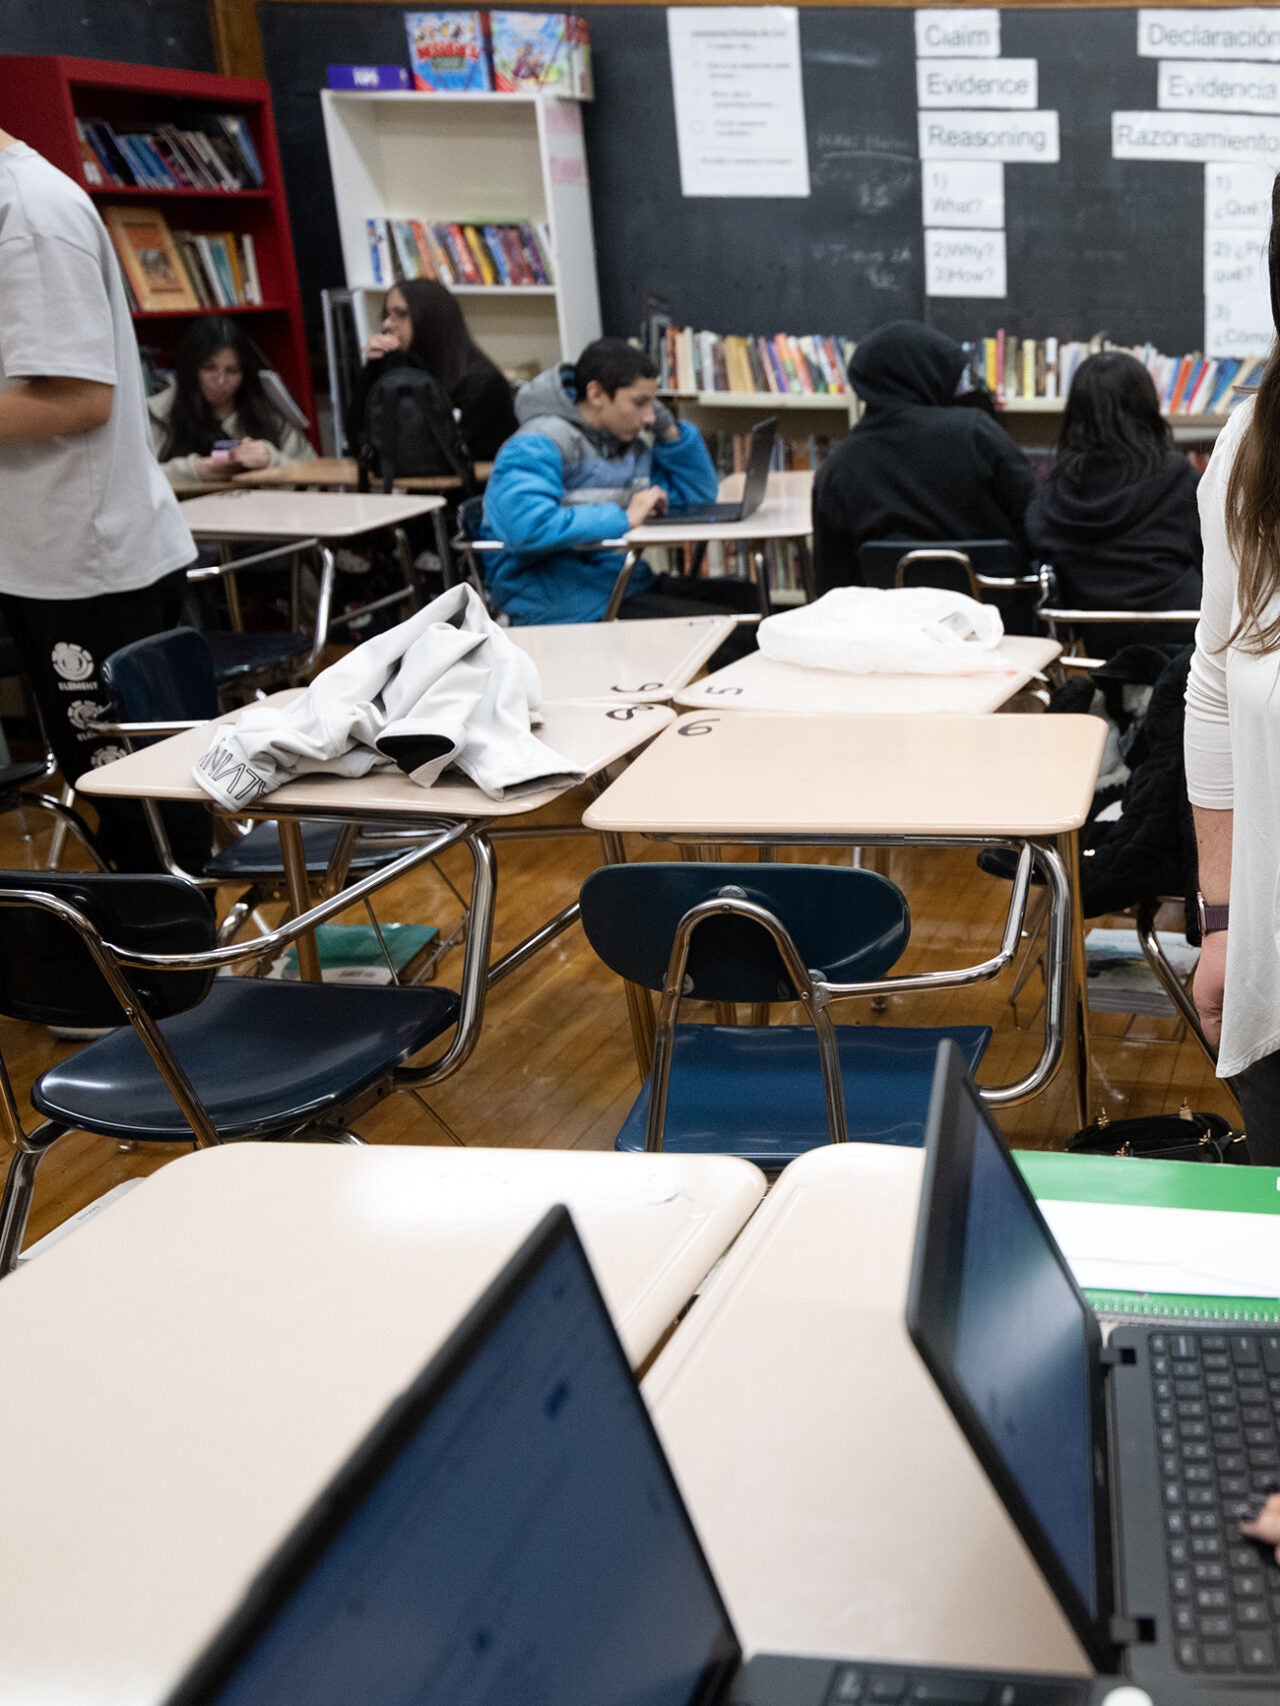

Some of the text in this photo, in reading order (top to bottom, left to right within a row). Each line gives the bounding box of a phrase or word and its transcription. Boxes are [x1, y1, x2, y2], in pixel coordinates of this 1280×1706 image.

[924, 24, 991, 47] Claim
[926, 72, 1029, 96] Evidence
[1167, 74, 1279, 100] Evidencia
[927, 124, 1046, 152] Reasoning
[1116, 125, 1280, 153] Razonamiento
[704, 686, 744, 696] 5
[605, 704, 655, 721] 8
[677, 718, 721, 737] 6
